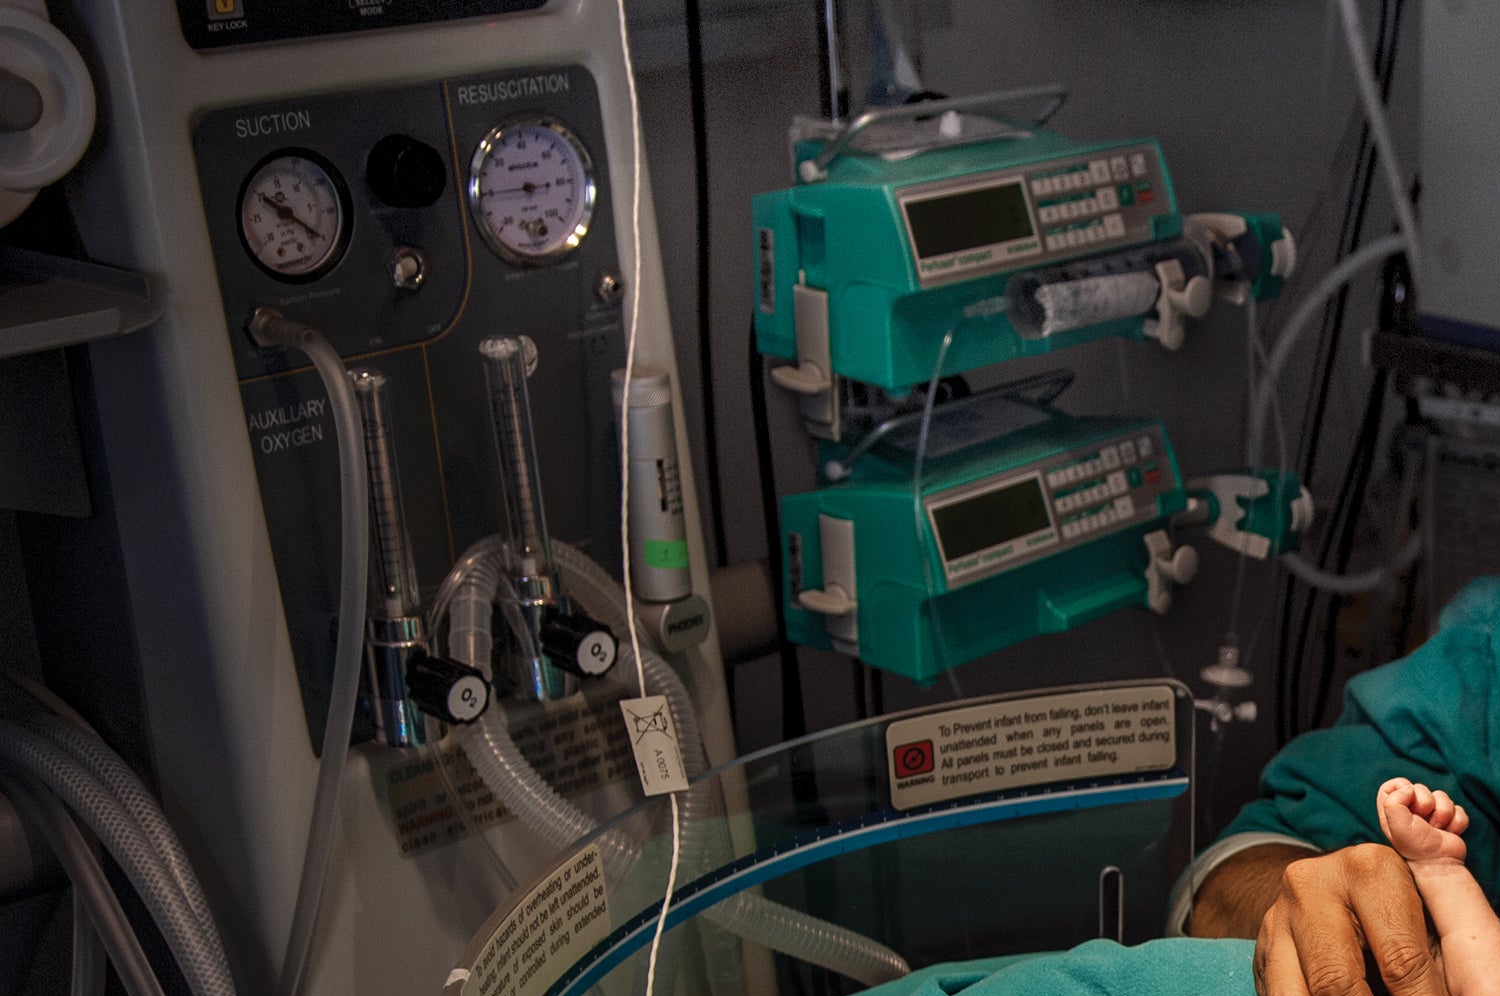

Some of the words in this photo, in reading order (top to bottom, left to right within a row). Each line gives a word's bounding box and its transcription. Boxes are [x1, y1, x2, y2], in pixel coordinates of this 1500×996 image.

[208, 22, 224, 32] KEY
[225, 20, 248, 30] LOCK
[457, 73, 570, 104] RESUSCITATION
[235, 110, 311, 138] SUCTION
[249, 398, 326, 431] AUXILLARY
[260, 425, 323, 455] OXYGEN
[460, 688, 478, 708] O2
[938, 726, 951, 738] To
[952, 719, 992, 736] Prevent
[994, 714, 1023, 728] infant
[1024, 712, 1048, 725] from
[1049, 706, 1081, 722] falling,
[1084, 704, 1110, 718] don't
[1111, 702, 1140, 714] leave
[1141, 699, 1170, 712] infant
[940, 734, 998, 755] unattended
[1005, 729, 1034, 744] when
[1042, 725, 1062, 741] any
[1070, 720, 1105, 736] panels
[1114, 718, 1132, 729] are
[1140, 714, 1170, 729] open.
[941, 756, 954, 770] All
[956, 751, 990, 770] panels
[993, 746, 1018, 760] must
[1020, 744, 1034, 756] be
[1036, 739, 1070, 754] closed
[1073, 736, 1092, 750] and
[1094, 732, 1136, 748] secured
[1138, 730, 1170, 744] during
[941, 767, 990, 787] transport
[994, 764, 1006, 777] to
[1010, 759, 1049, 778] prevent
[1054, 754, 1082, 768] infant
[1086, 749, 1120, 766] falling.
[896, 776, 936, 791] WARNING
[496, 920, 517, 950] hazards
[518, 908, 526, 924] of
[525, 878, 562, 917] overheating
[564, 868, 572, 880] or
[574, 852, 598, 874] under-
[510, 926, 528, 958] should
[530, 918, 540, 939] not
[540, 908, 549, 926] be
[548, 898, 560, 919] left
[560, 867, 600, 906] unattended.
[512, 958, 520, 974] of
[521, 930, 546, 966] exposed
[548, 916, 564, 936] skin
[567, 896, 590, 921] should
[594, 884, 604, 899] be
[519, 950, 546, 988] controlled
[550, 930, 570, 956] during
[574, 900, 606, 934] extended
